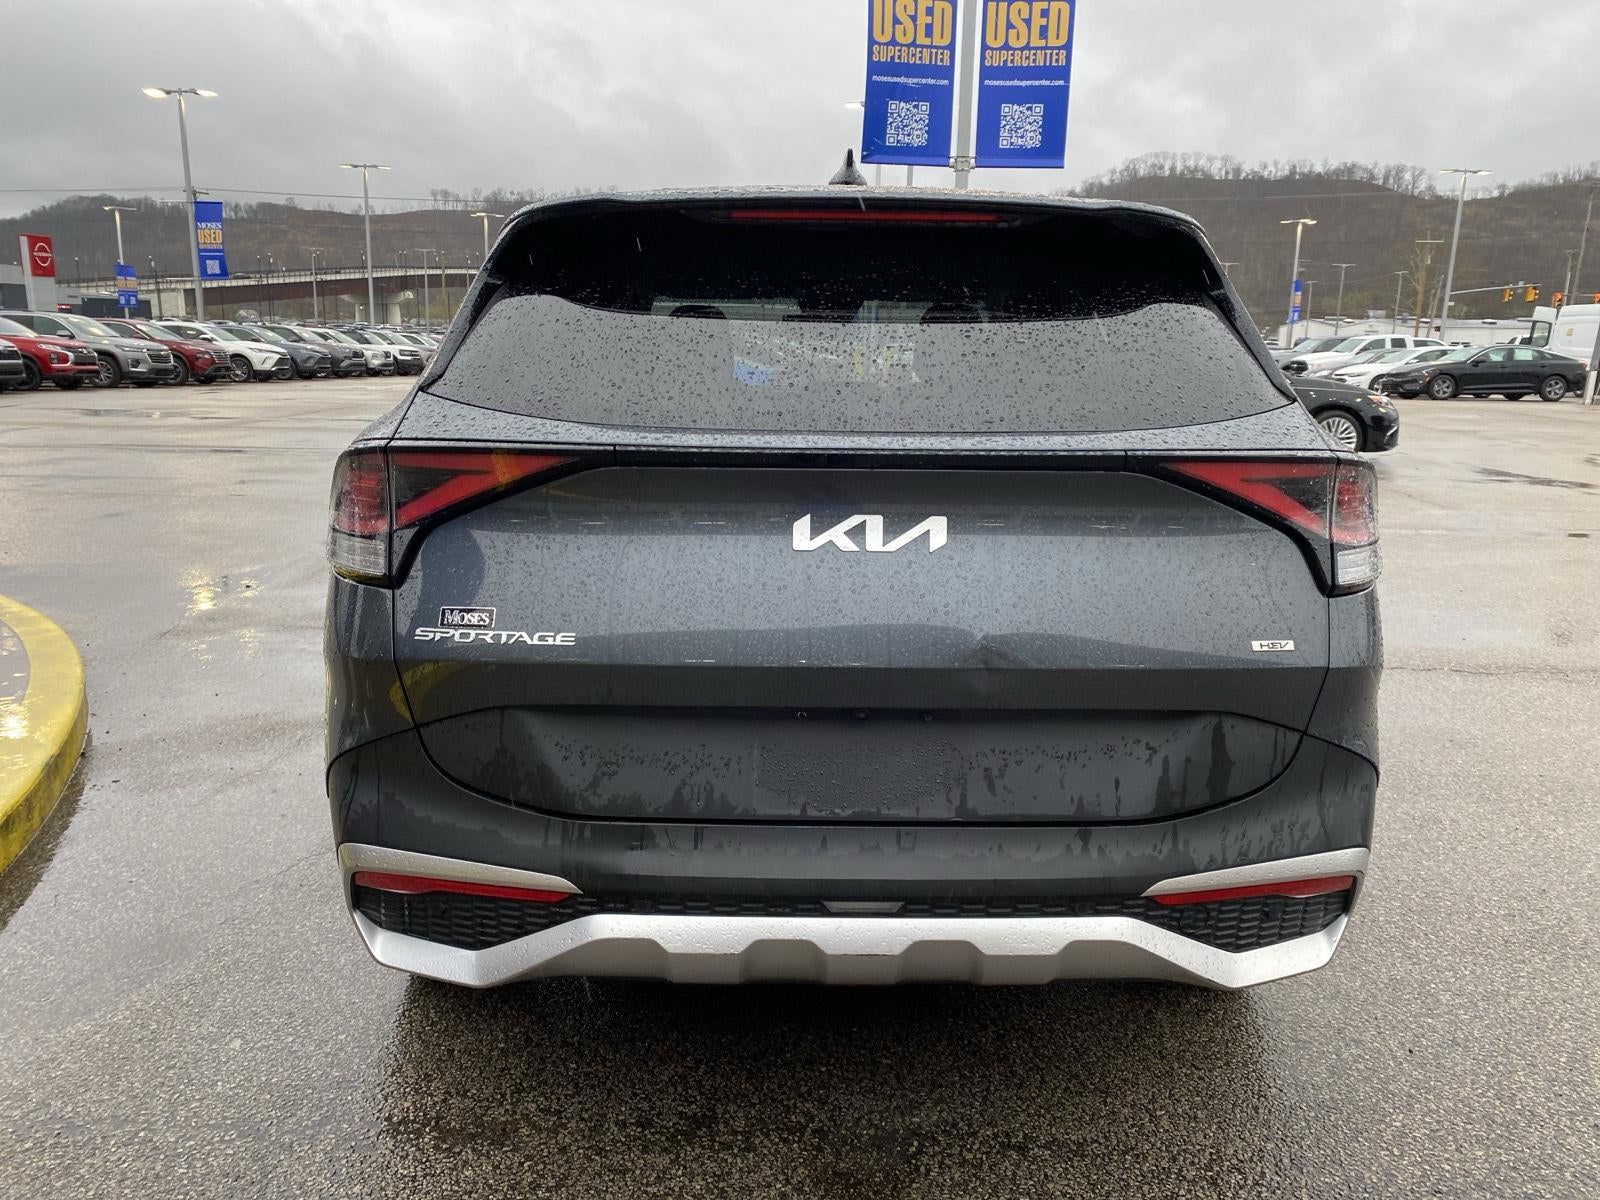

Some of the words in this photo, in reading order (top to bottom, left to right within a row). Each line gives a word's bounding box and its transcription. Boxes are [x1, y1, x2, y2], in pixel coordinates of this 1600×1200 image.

[872, 0, 953, 47] USED
[985, 1, 1071, 48] USED
[872, 45, 950, 66] SUPERCENTER
[985, 50, 1066, 67] SUPERCENTER
[872, 74, 949, 86] mosesusedsupercenter.com
[984, 79, 1065, 87] mosesusedsupercenter.com
[197, 229, 223, 244] USED
[414, 627, 576, 646] SPORTAGE
